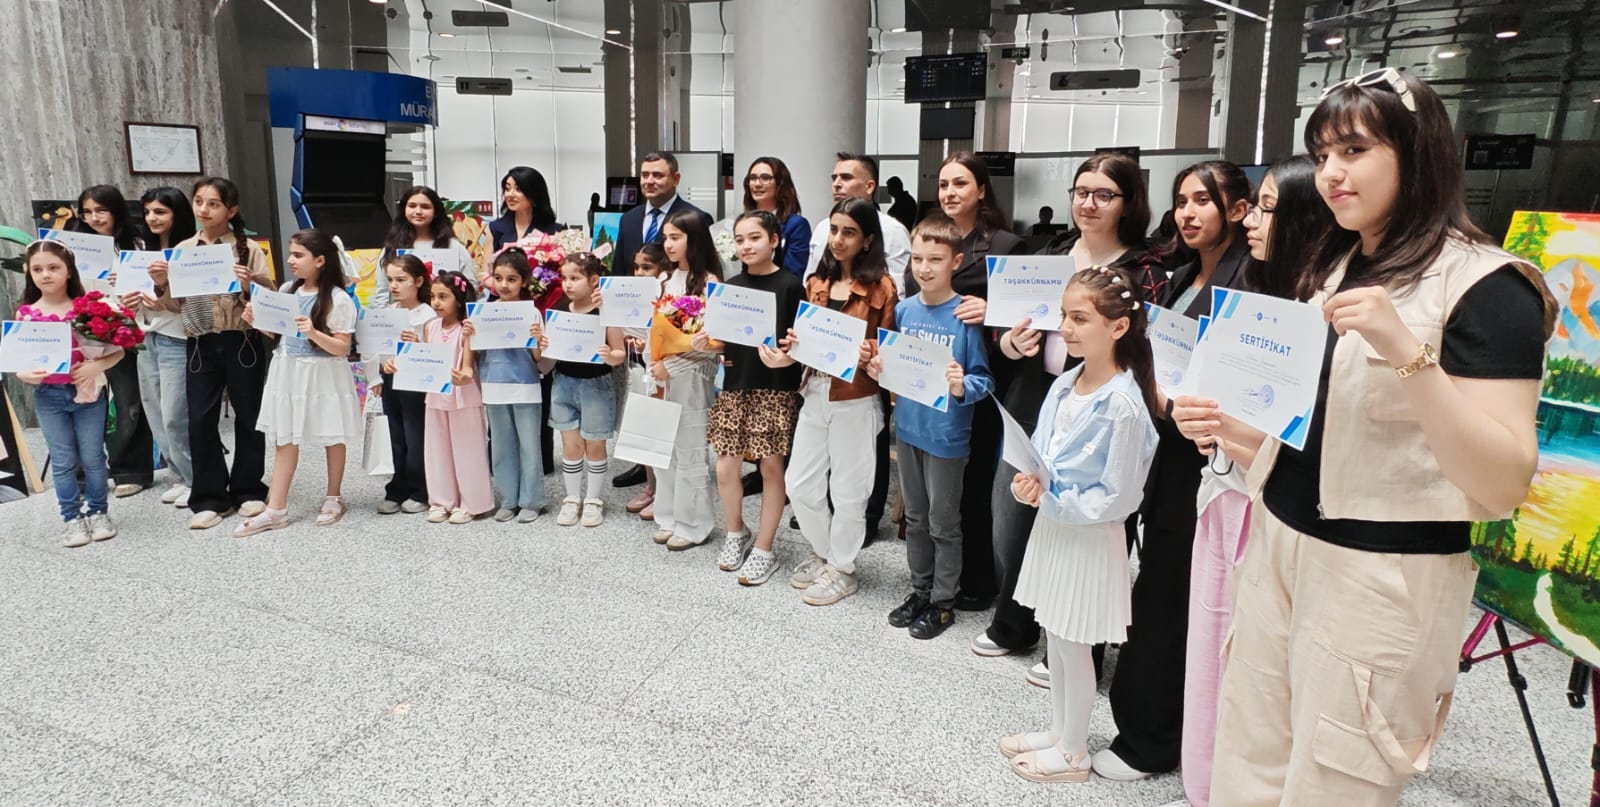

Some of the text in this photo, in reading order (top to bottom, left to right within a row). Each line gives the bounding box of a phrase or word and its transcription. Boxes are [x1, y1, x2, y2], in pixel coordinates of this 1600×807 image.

[1004, 277, 1062, 286] TƏŞƏKKÜRNAMƏ
[1154, 330, 1193, 353] TƏŞƏKKÜRNA
[1239, 333, 1292, 358] SERTİFİKAT
